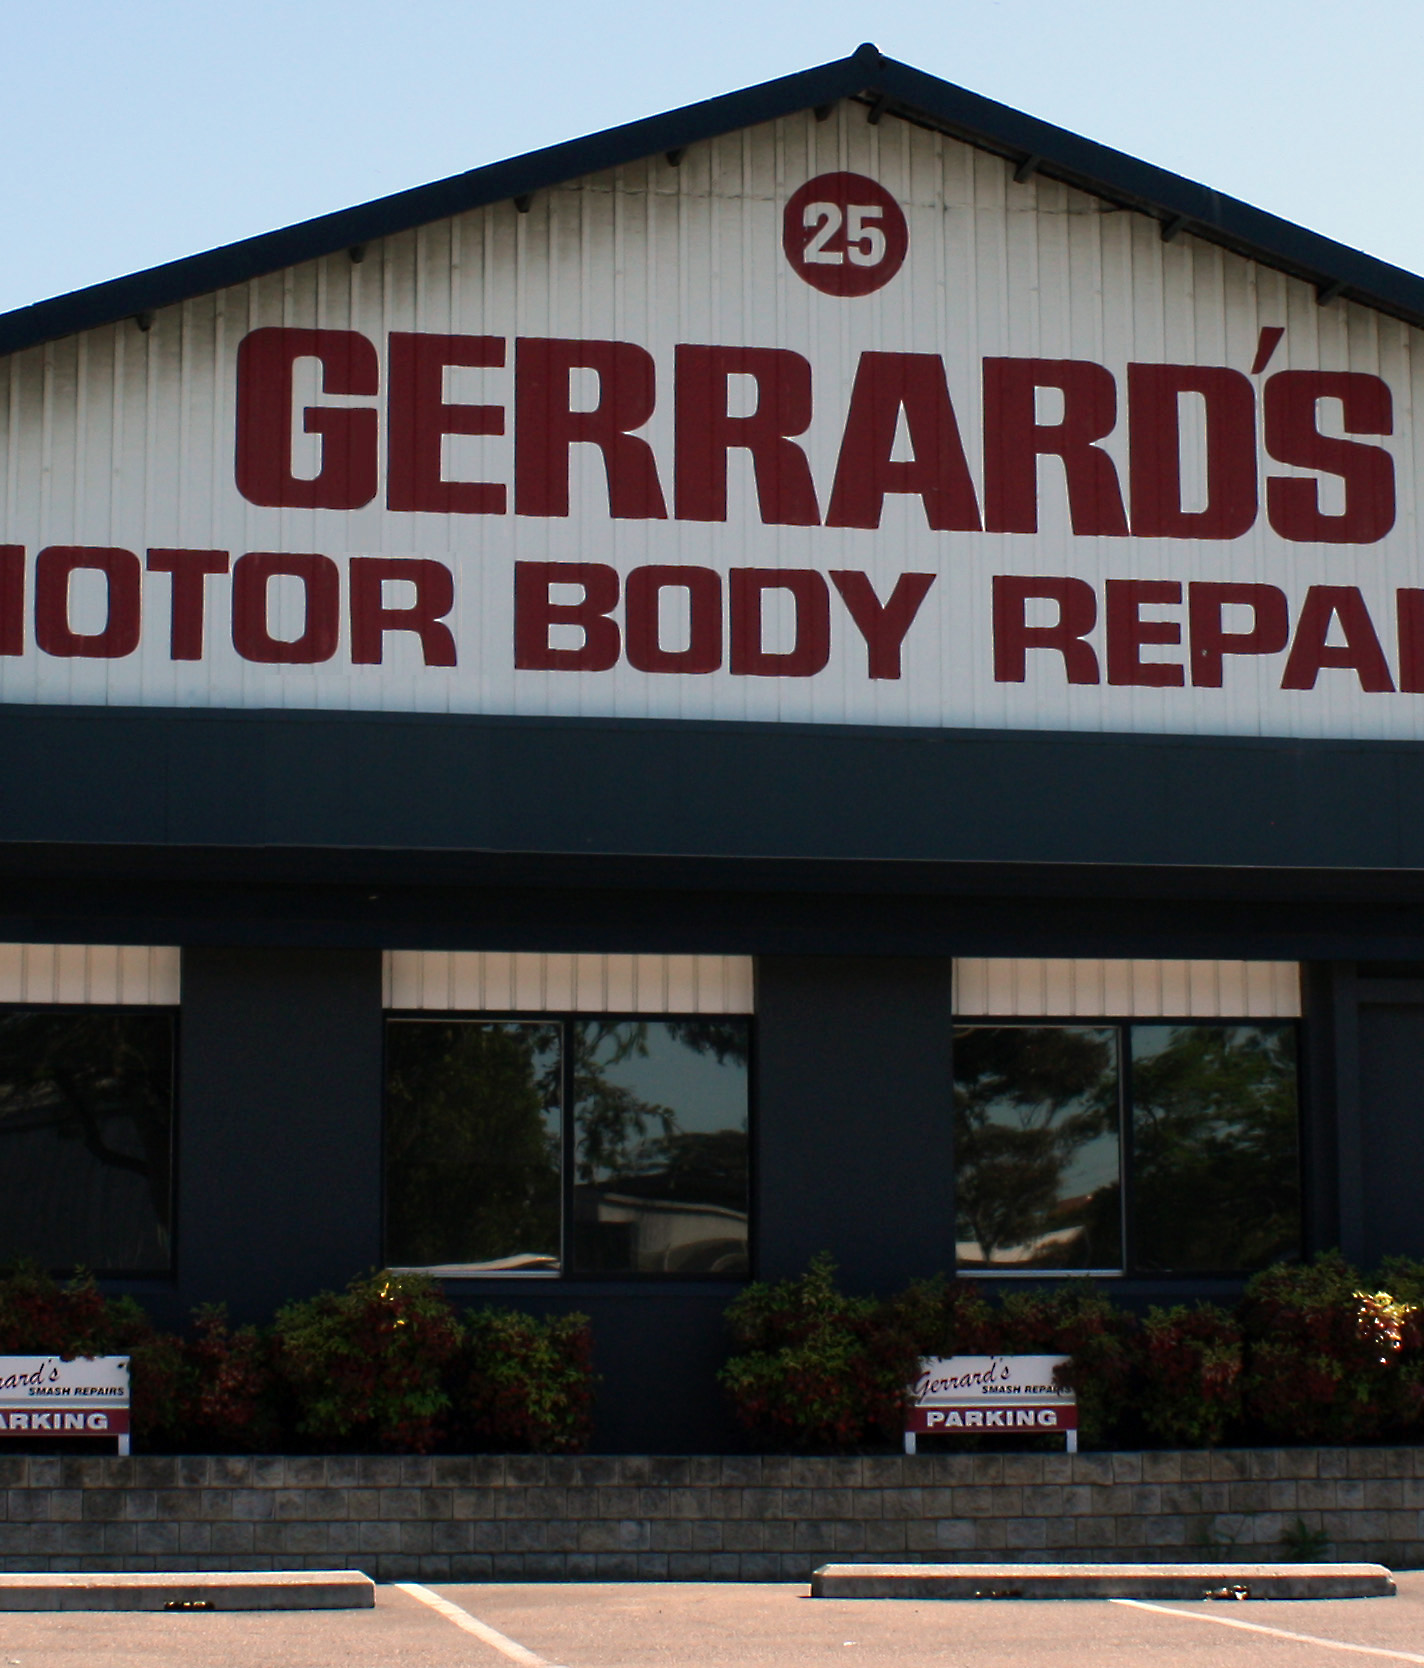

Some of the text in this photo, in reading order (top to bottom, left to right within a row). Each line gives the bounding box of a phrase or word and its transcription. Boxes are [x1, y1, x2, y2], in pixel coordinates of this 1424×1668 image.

[801, 203, 887, 267] 25
[236, 326, 1395, 543] GERRARD'S
[516, 562, 935, 679] BODY
[29, 1386, 125, 1396] SMASH REPAIRS
[913, 1358, 1011, 1405] Gerrard's
[982, 1385, 1021, 1394] SMASH
[926, 1409, 1058, 1427] PARKING
